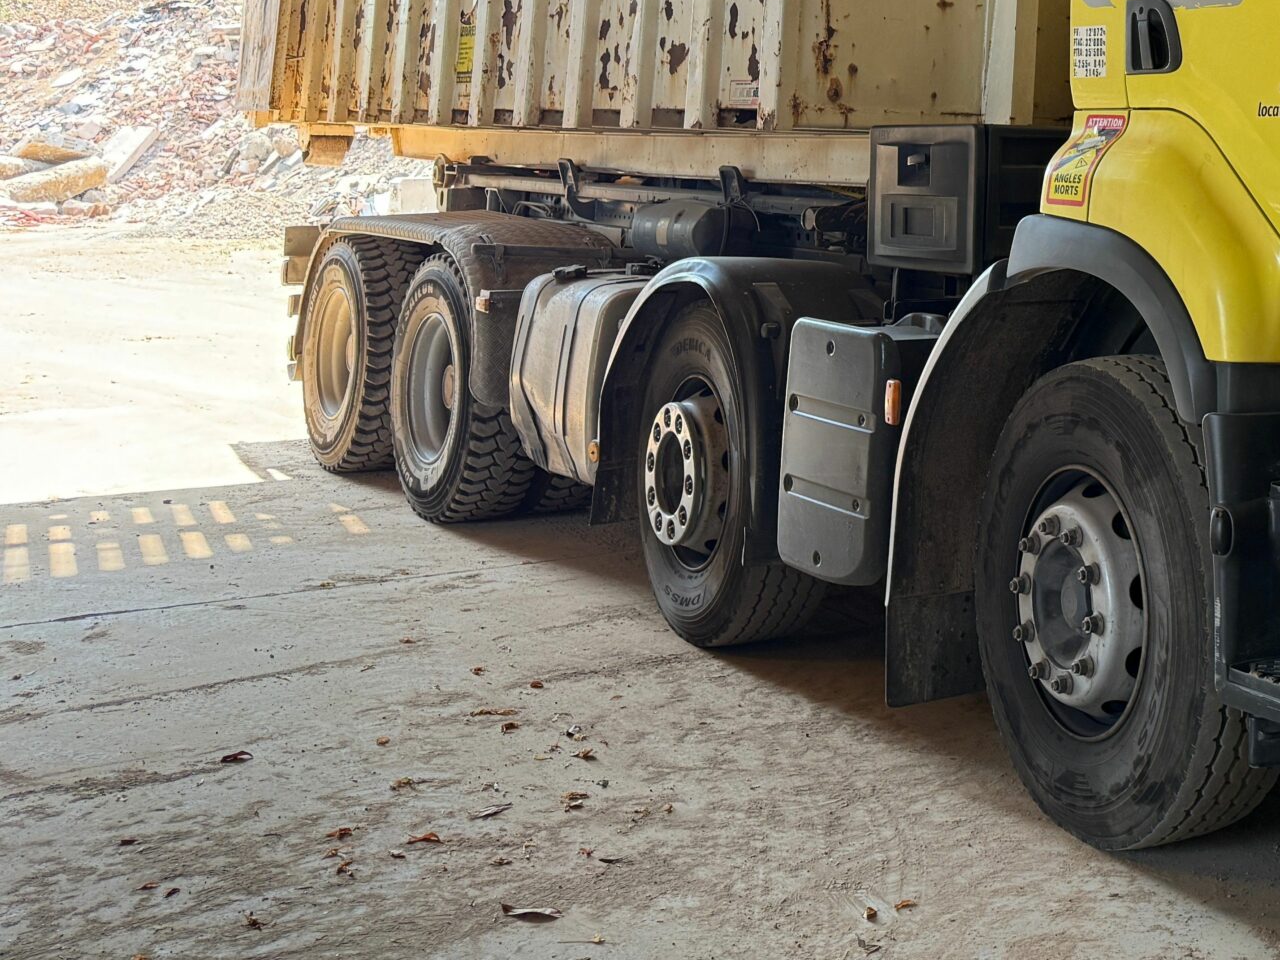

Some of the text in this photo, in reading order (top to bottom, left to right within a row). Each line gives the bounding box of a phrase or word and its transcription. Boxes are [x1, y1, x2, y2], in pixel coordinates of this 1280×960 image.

[1087, 117, 1124, 127] ATTENTION
[1054, 172, 1082, 184] ANGLES
[1054, 184, 1079, 196] MORTS
